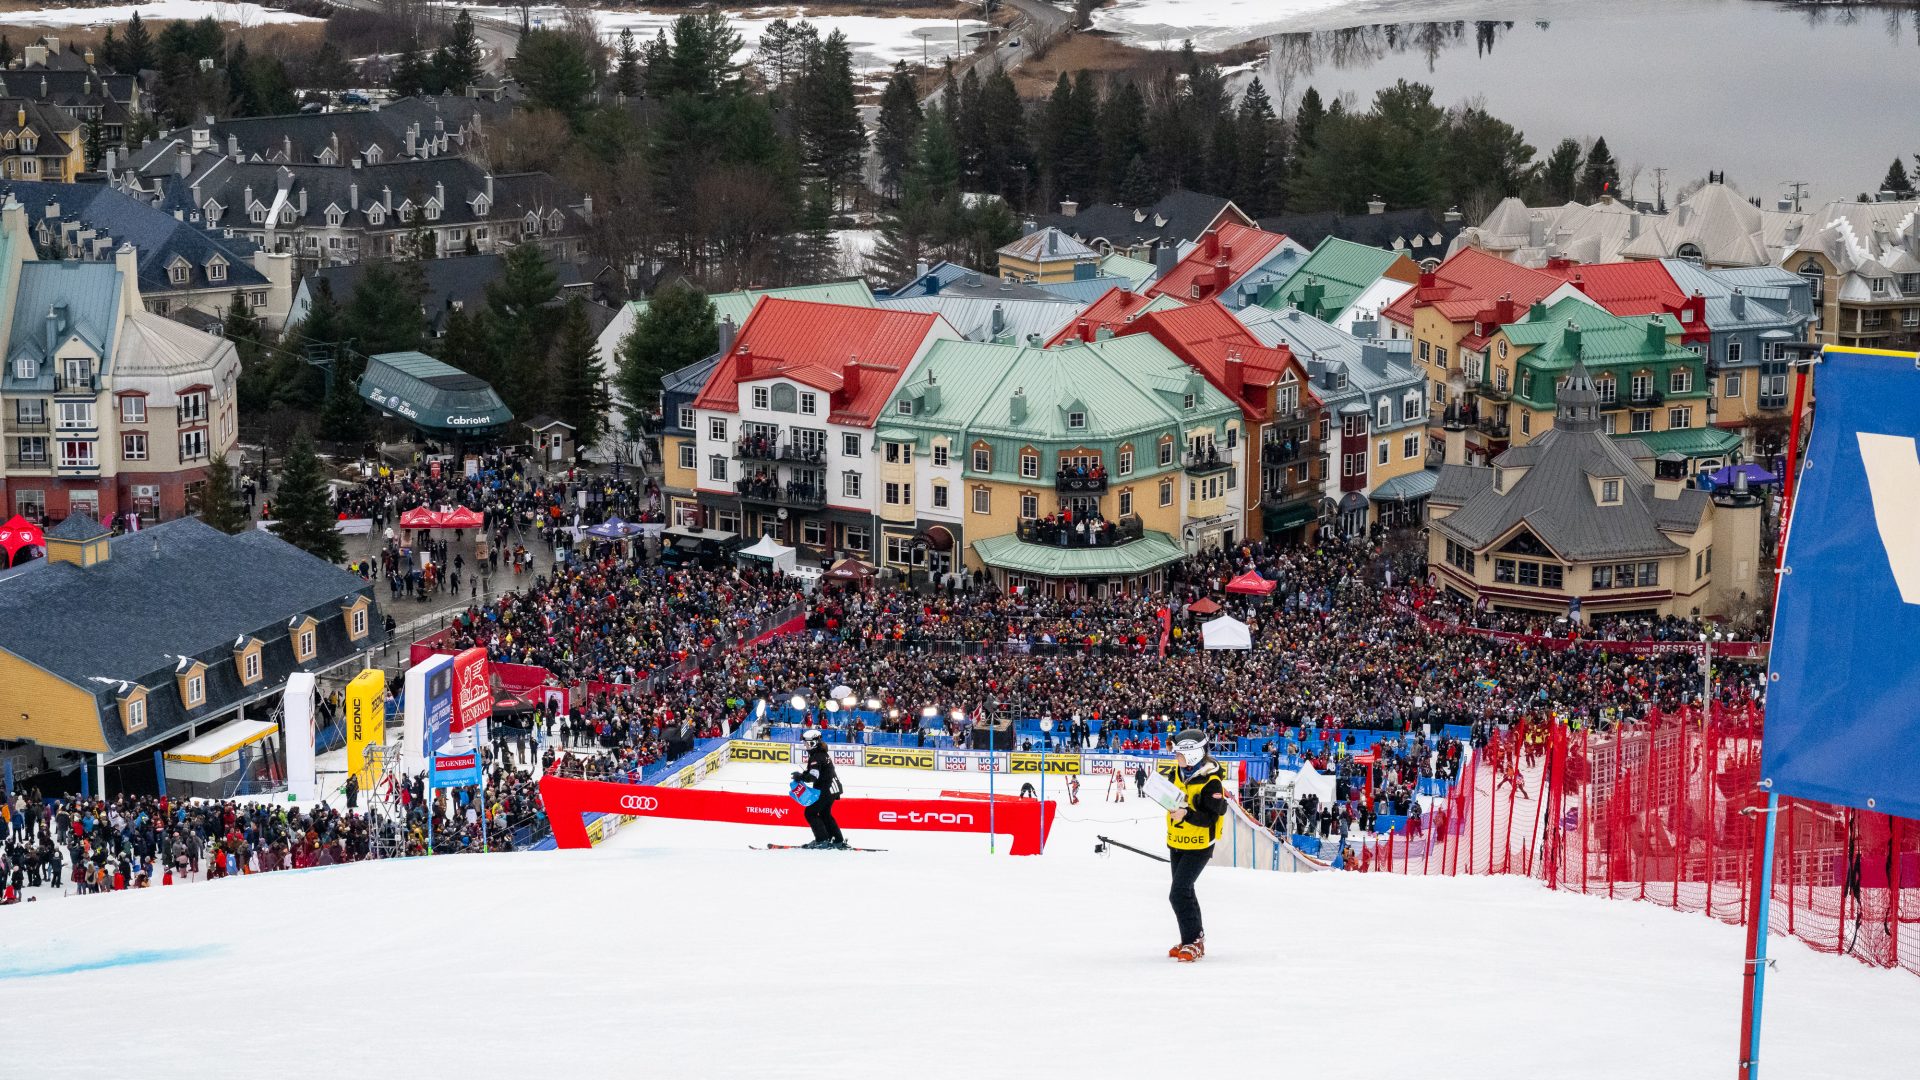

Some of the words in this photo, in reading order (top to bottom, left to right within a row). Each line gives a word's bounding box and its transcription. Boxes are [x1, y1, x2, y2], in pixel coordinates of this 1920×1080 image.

[446, 415, 490, 425] Cabriolet
[463, 698, 490, 724] GENERALI
[354, 698, 362, 740] ZGONC
[730, 748, 789, 761] ZGONC
[866, 754, 932, 767] ZGONC
[445, 758, 475, 767] GENERALI
[1012, 760, 1079, 772] ZGONC
[746, 806, 789, 819] TREMBLANT
[878, 810, 974, 825] e-tron
[1173, 835, 1204, 844] JUDGE
